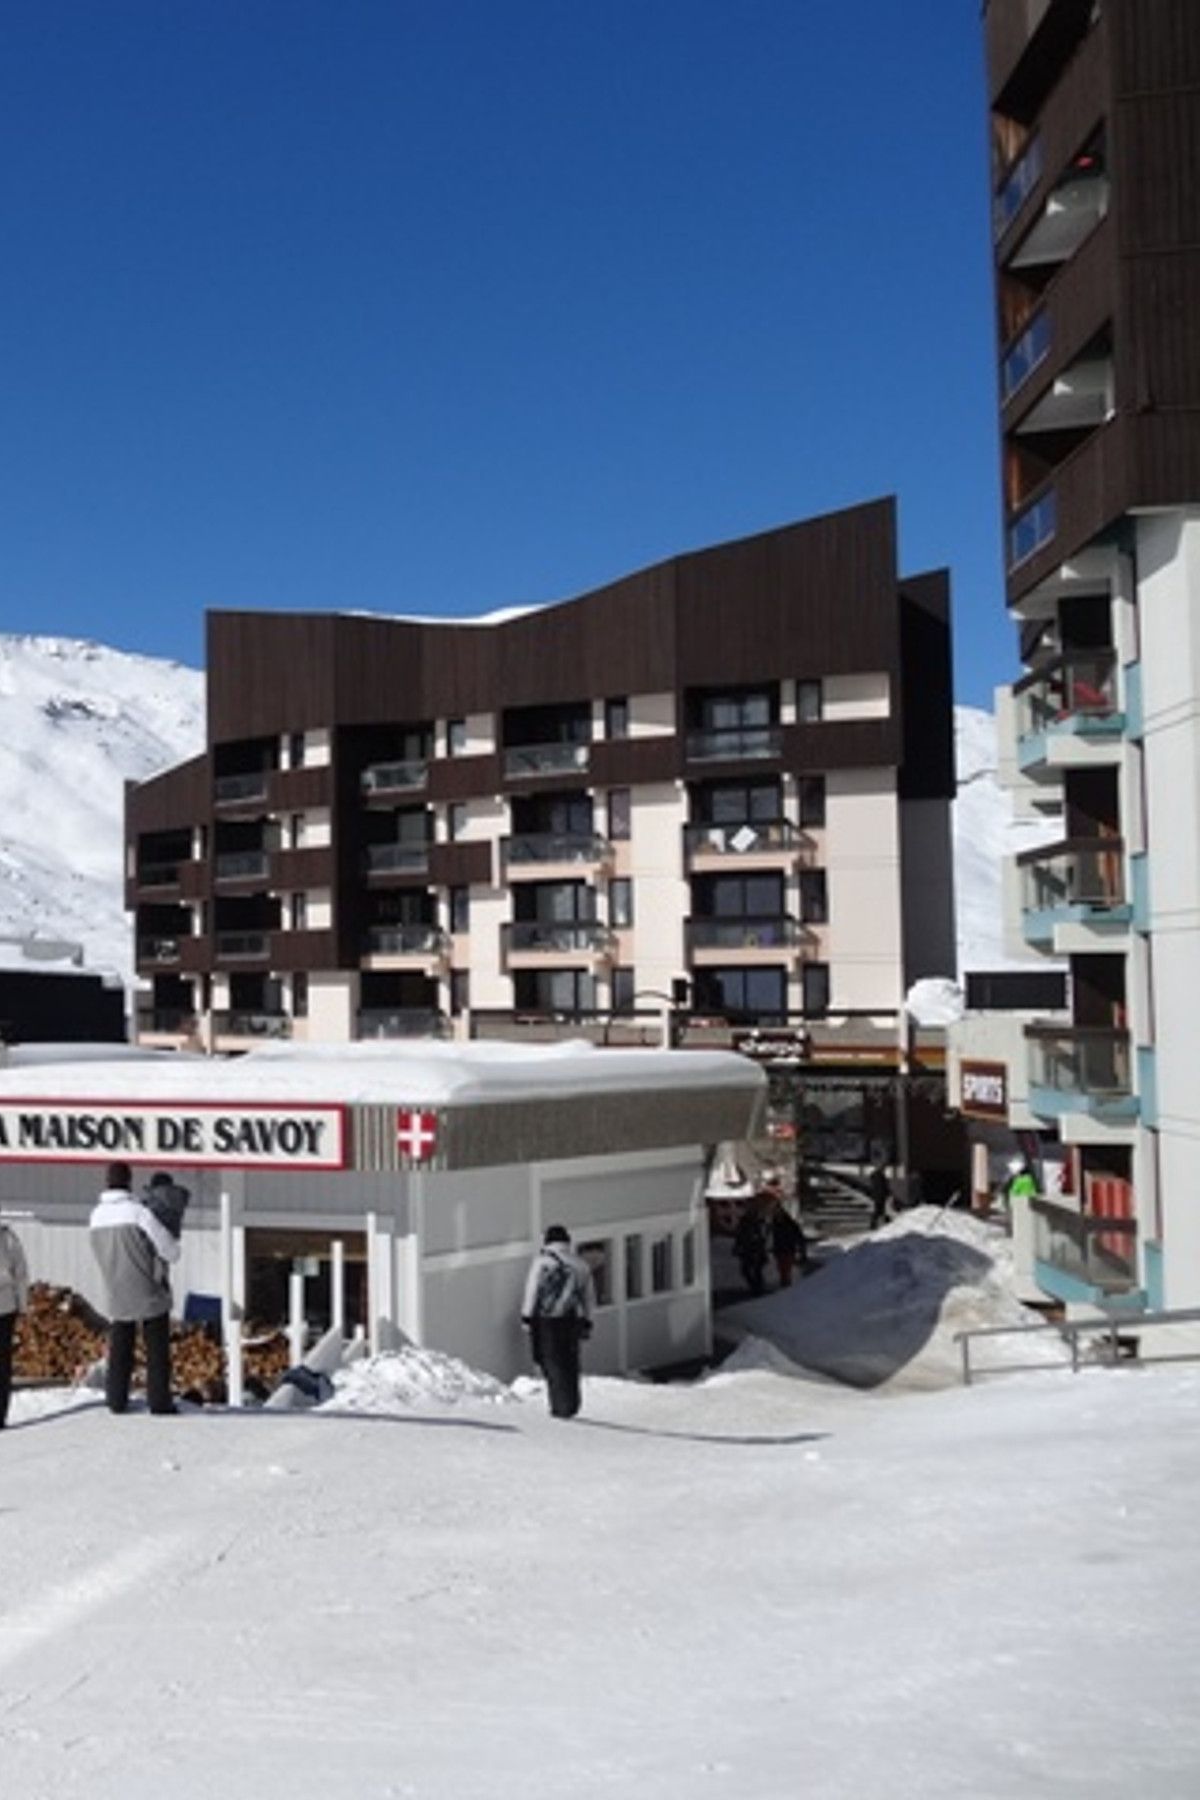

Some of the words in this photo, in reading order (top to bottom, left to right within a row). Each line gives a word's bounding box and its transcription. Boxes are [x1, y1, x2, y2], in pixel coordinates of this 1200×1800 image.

[18, 1113, 145, 1150] MAISON
[157, 1117, 203, 1153] DE
[213, 1117, 325, 1155] SAVOY
